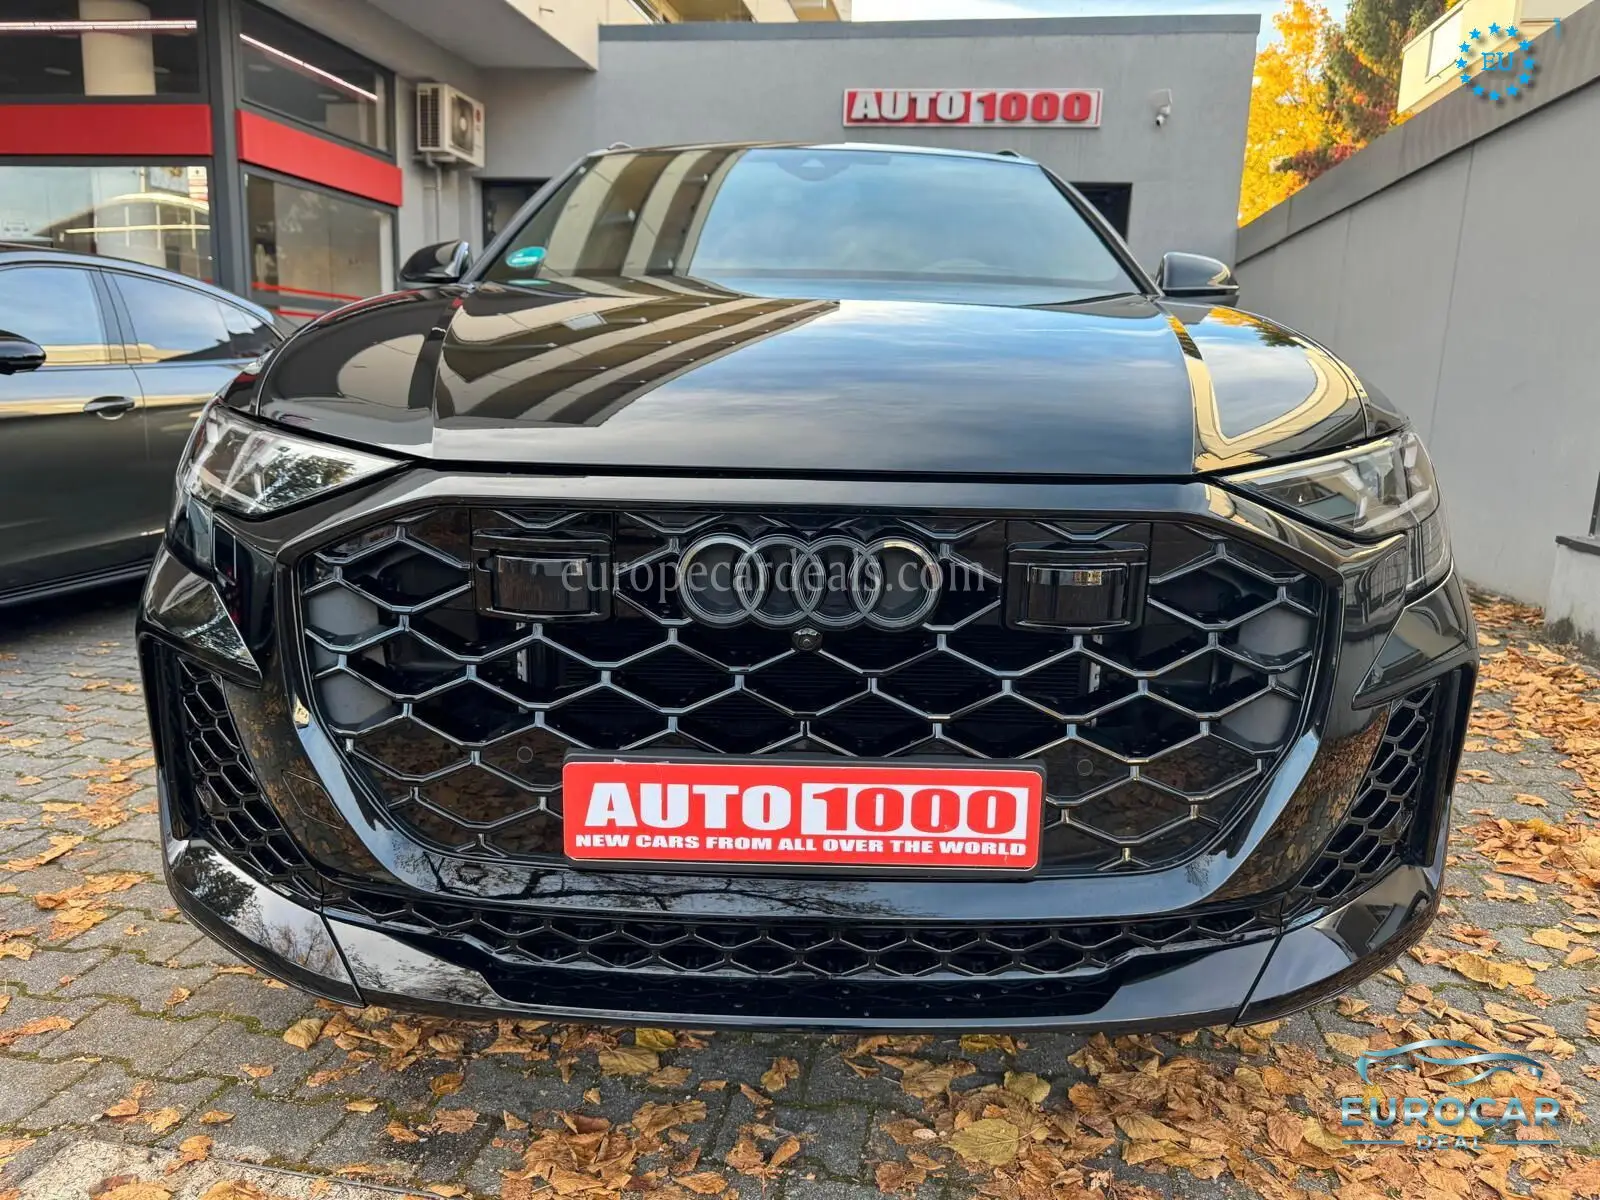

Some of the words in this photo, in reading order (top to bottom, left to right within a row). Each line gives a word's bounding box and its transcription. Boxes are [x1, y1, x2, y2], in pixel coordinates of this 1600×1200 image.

[851, 91, 966, 121] AUTO
[977, 91, 1092, 122] 1000
[584, 782, 792, 831] AUTO
[812, 787, 1017, 835] 1000
[575, 834, 630, 848] NEW
[635, 835, 700, 849] CARS
[705, 836, 773, 851] FROM
[777, 837, 817, 851] ALL
[822, 839, 884, 852] OVER
[890, 840, 933, 854] THE
[939, 841, 1027, 856] WORLD
